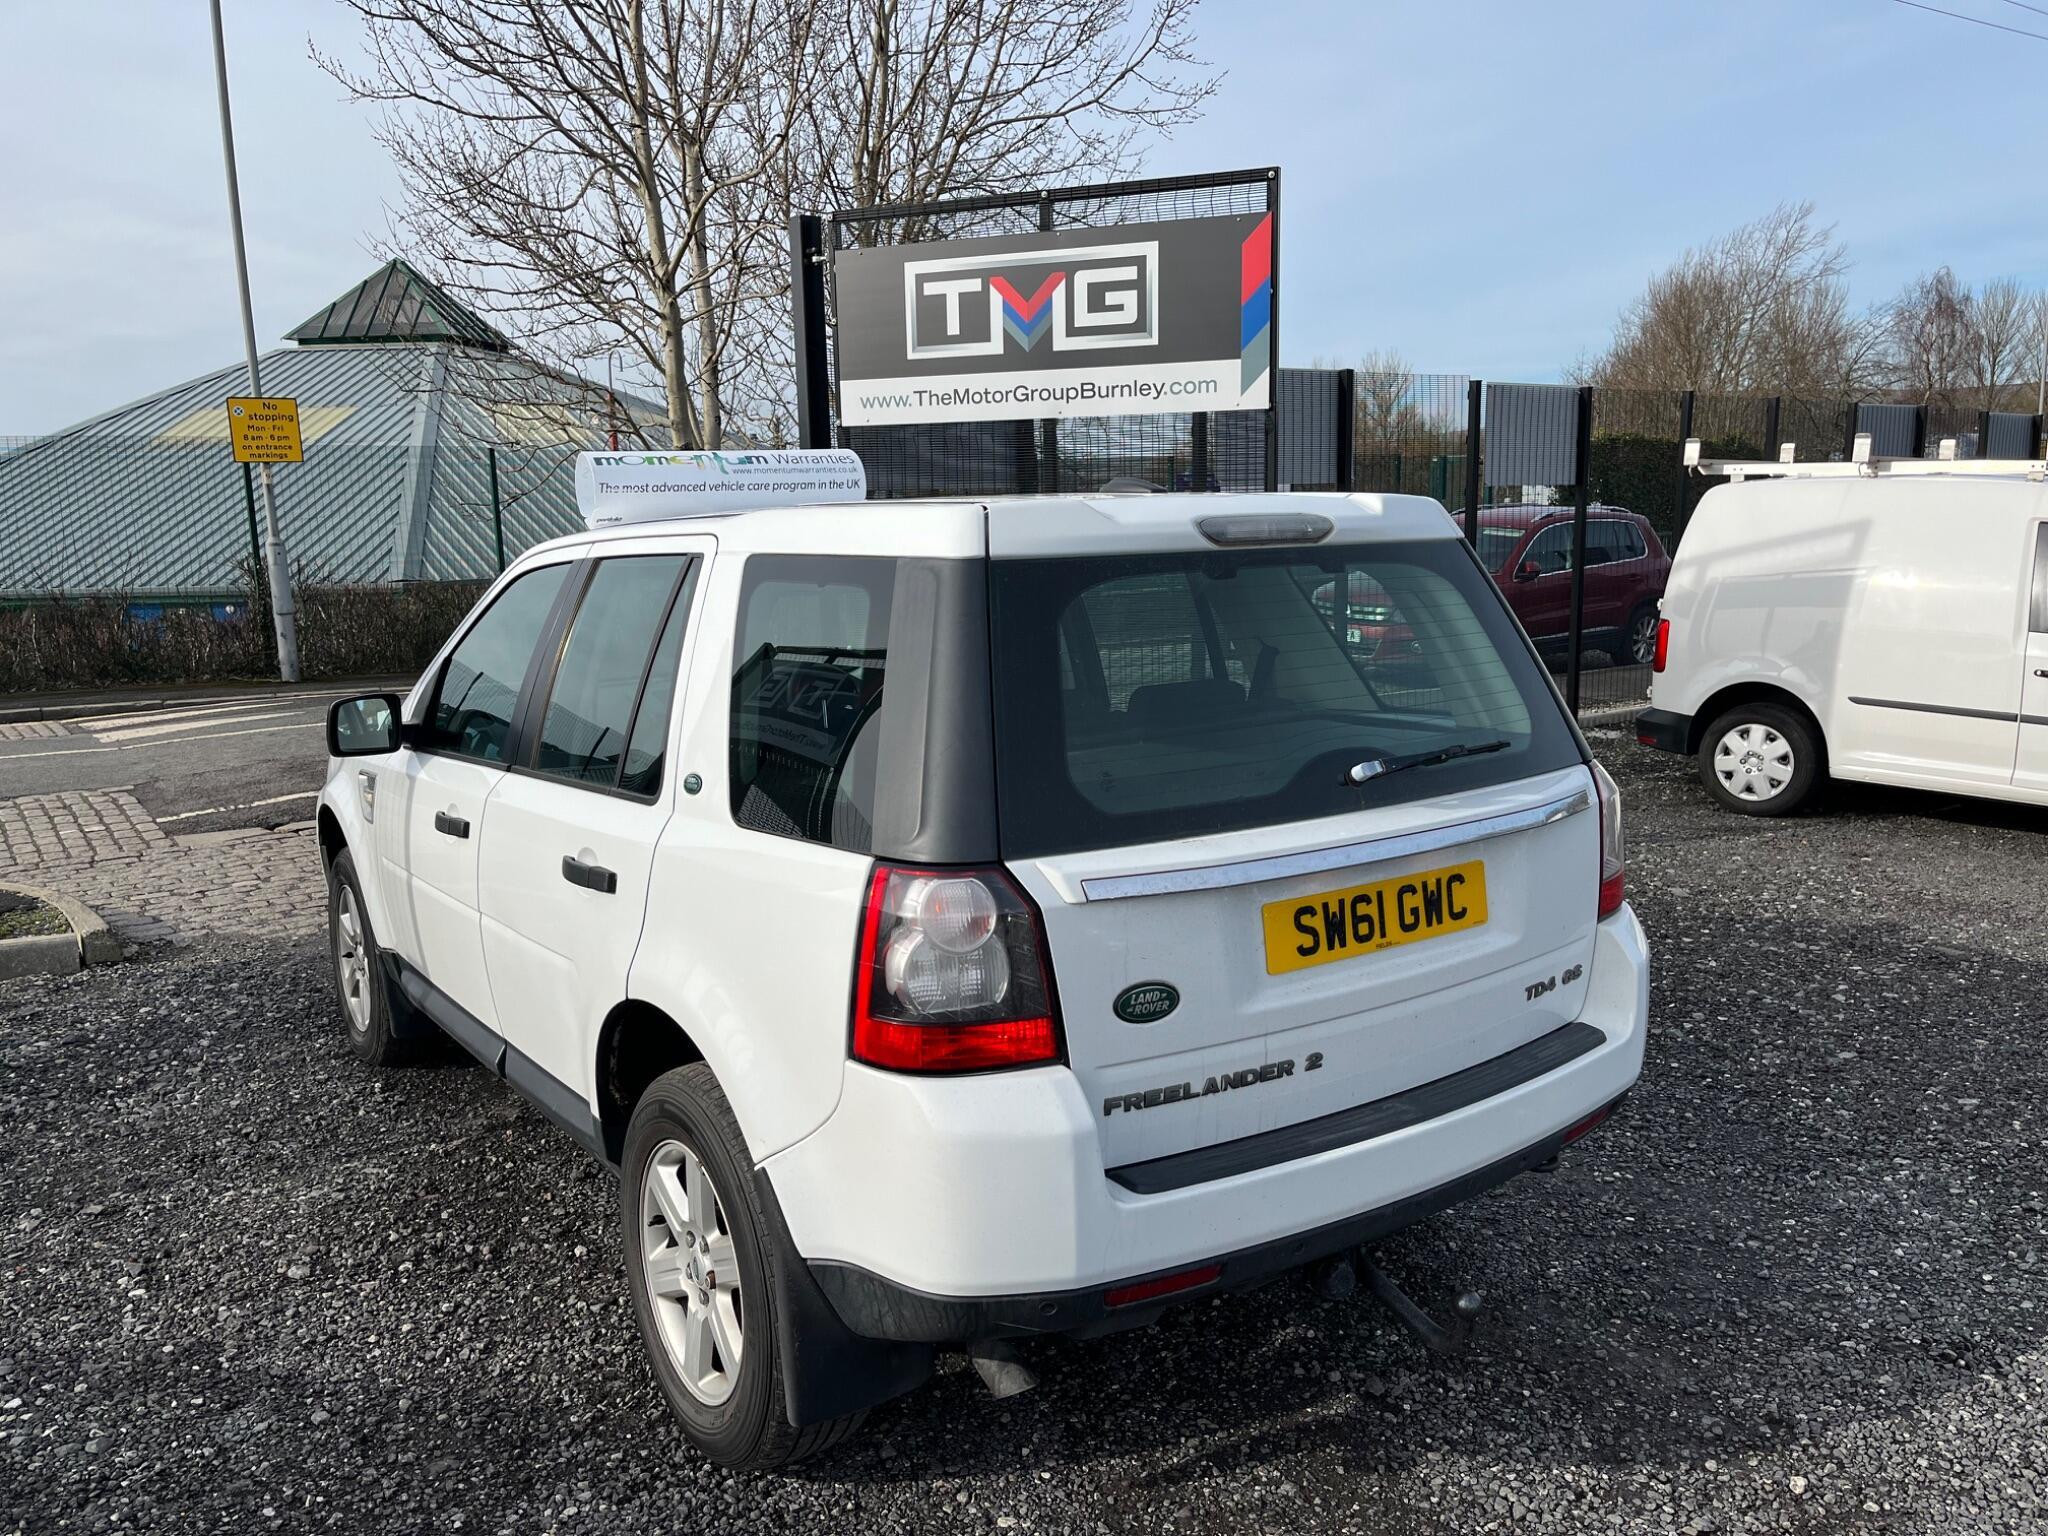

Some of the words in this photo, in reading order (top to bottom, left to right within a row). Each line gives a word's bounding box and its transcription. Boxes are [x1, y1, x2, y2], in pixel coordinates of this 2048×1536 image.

[923, 265, 1138, 353] TMG
[860, 378, 1217, 409] www.TheMotorGroupBurnley.com
[262, 402, 278, 410] No
[248, 412, 294, 422] stopping
[247, 424, 266, 432] Mon
[272, 424, 284, 432] Fri
[255, 443, 293, 451] entrance
[593, 452, 769, 475] momentum
[771, 453, 855, 465] Warranties
[599, 482, 620, 494] The
[622, 483, 649, 493] most
[651, 481, 706, 493] advanced
[708, 480, 744, 492] vehicle
[747, 480, 770, 491] care
[772, 480, 816, 492] program
[818, 480, 829, 490] in
[830, 479, 845, 490] the
[846, 479, 861, 489] UK
[1293, 890, 1387, 957] SW61
[1397, 873, 1468, 933] GWC
[1130, 991, 1161, 1005] LAND
[1133, 1000, 1170, 1015] ROVER
[1103, 1059, 1296, 1116] FREELANDER
[1304, 1052, 1324, 1072] 2
